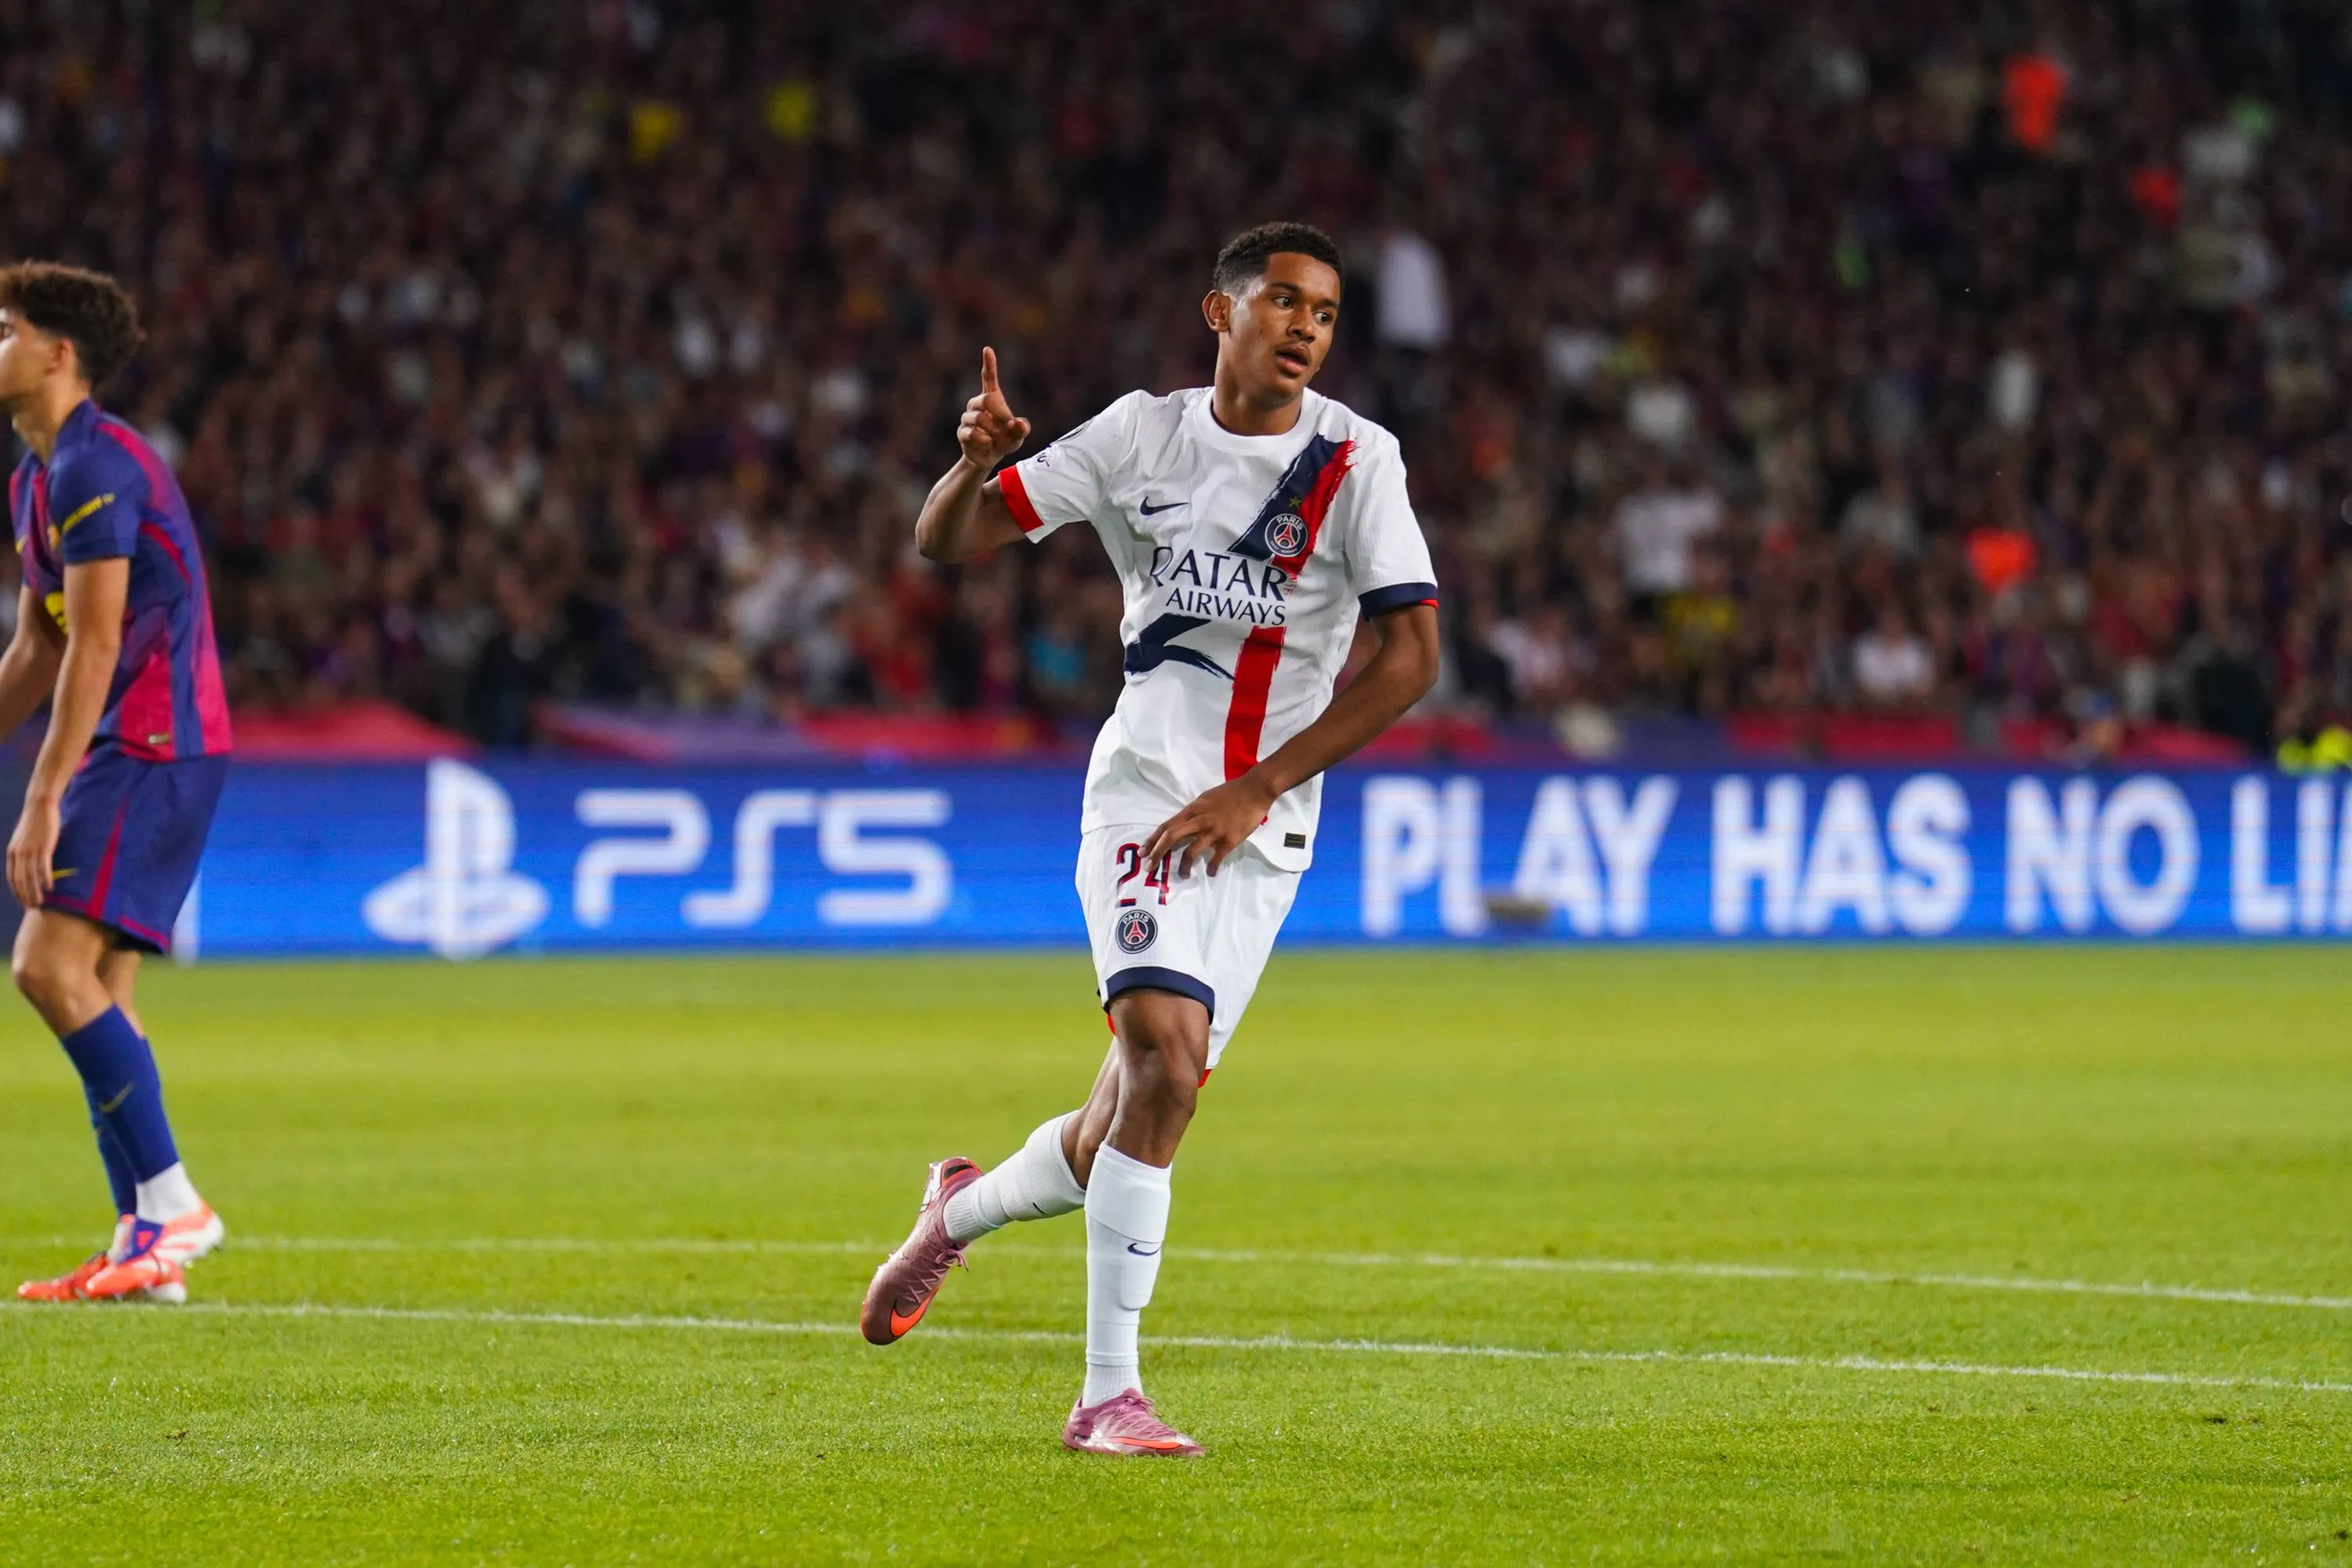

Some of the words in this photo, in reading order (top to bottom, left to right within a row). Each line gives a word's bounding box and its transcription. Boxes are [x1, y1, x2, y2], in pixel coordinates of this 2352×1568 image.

[1276, 516, 1305, 530] PARIS
[1149, 546, 1285, 601] QATAR
[1166, 588, 1286, 626] AIRWAYS
[574, 789, 953, 927] PS5
[1116, 843, 1173, 907] 24
[1360, 774, 1680, 936] PLAY
[1711, 773, 1973, 935] HAS
[2005, 773, 2199, 935] NO
[2230, 774, 2352, 934] LI
[1122, 913, 1150, 924] PARIS
